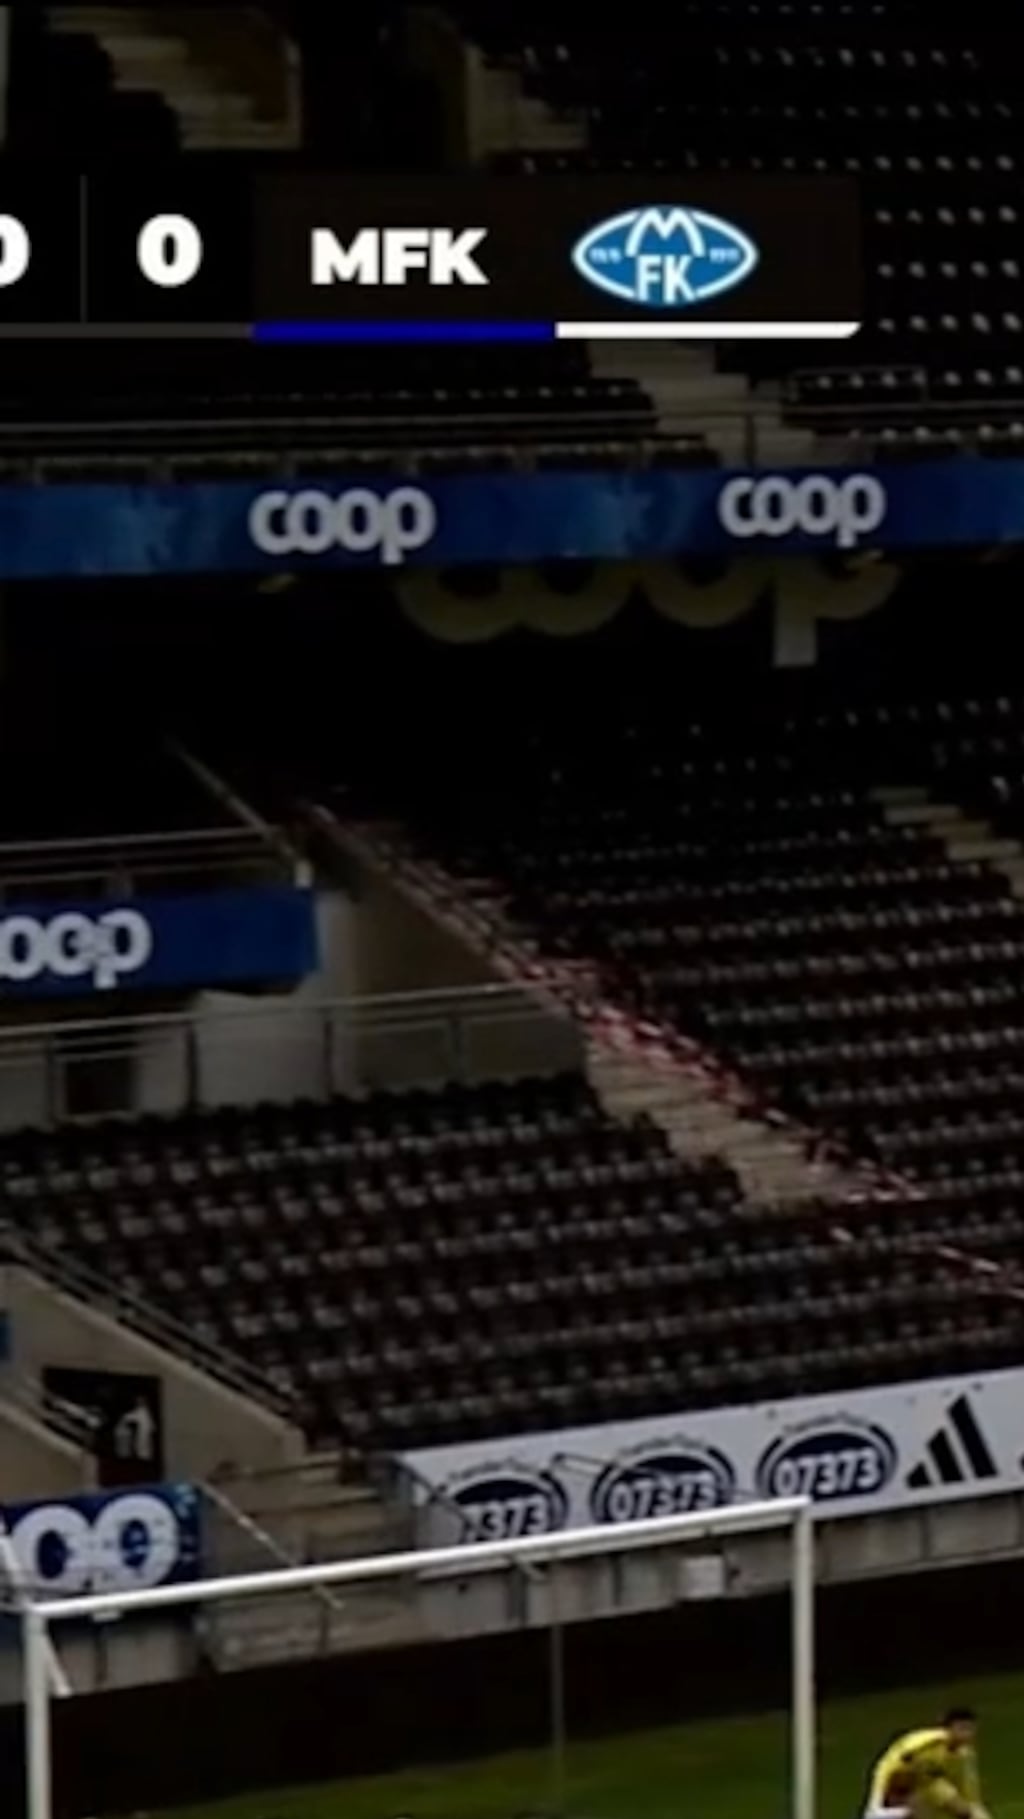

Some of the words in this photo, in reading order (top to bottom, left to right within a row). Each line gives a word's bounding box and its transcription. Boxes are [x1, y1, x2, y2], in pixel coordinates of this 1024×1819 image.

[249, 487, 437, 564] coop
[718, 474, 886, 548] coop
[0, 908, 152, 990] oop
[774, 1446, 882, 1497] 07373
